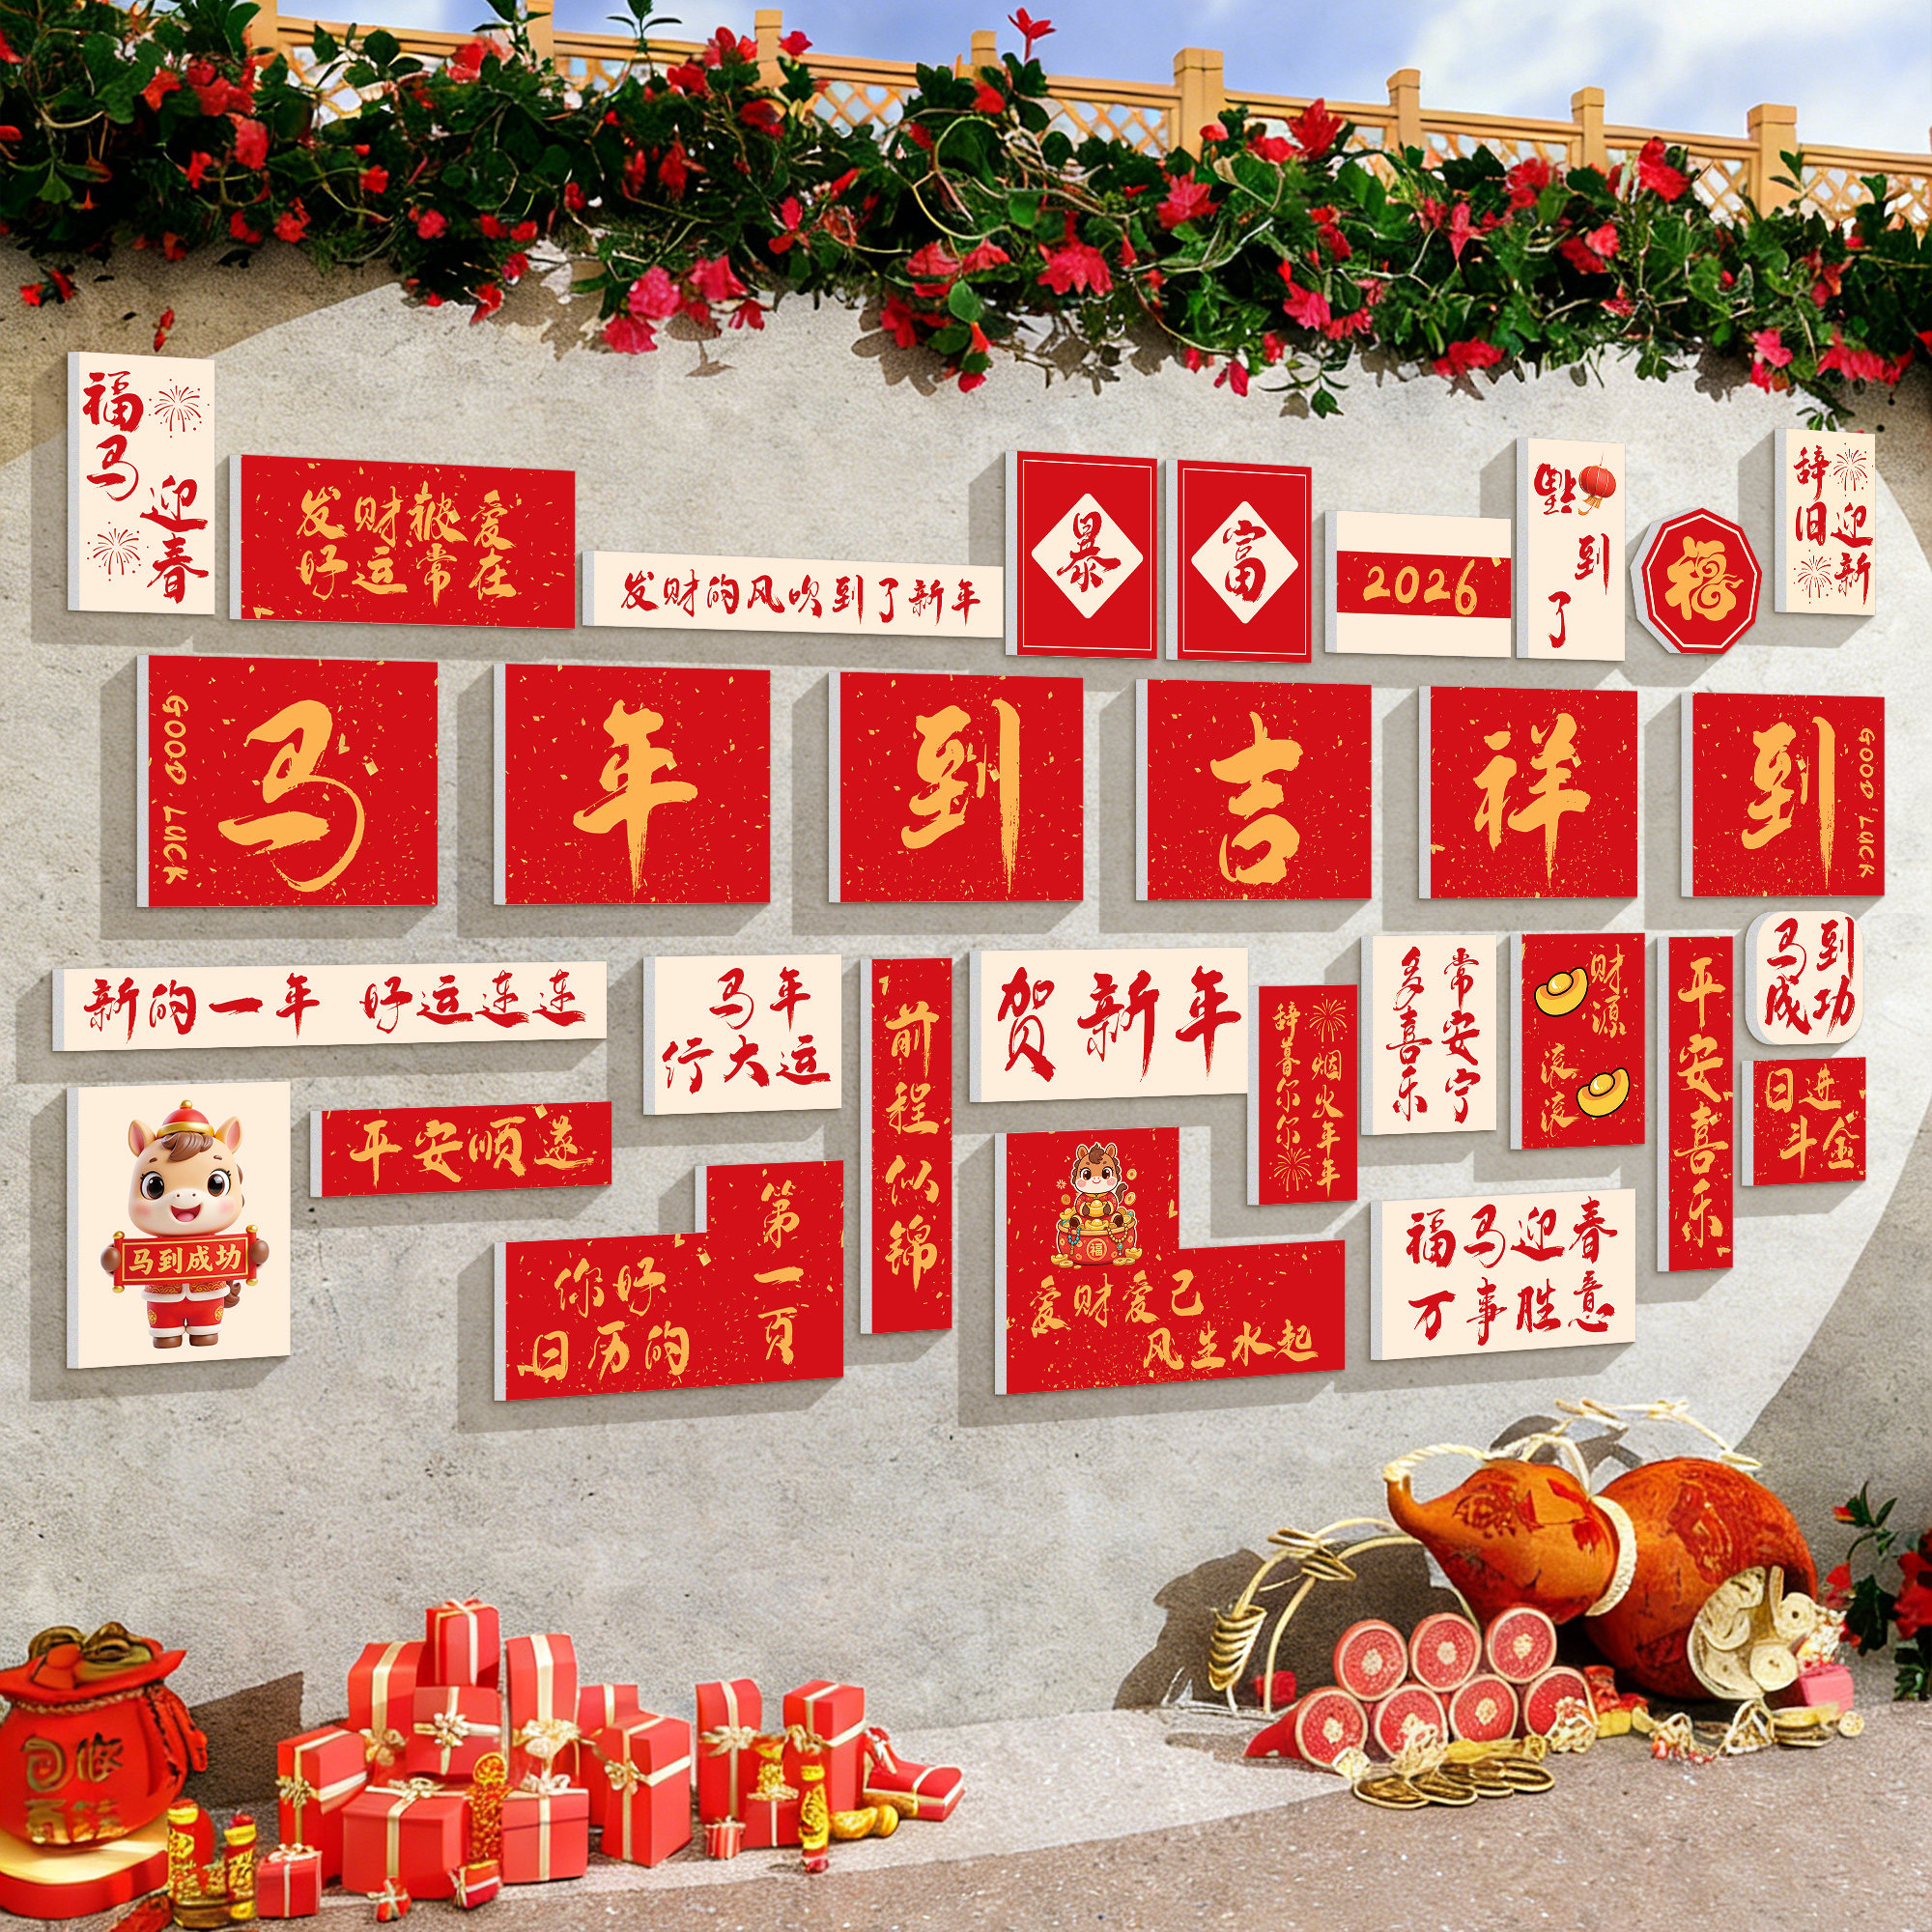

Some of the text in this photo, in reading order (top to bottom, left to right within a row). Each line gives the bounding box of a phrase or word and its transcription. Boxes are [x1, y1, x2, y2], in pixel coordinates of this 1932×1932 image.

[83, 371, 143, 501] 福马
[296, 481, 516, 551] 发财被爱
[1794, 445, 1831, 546] 辞旧
[140, 474, 209, 604] 迎春
[296, 543, 517, 608] 好运常在
[1056, 510, 1121, 593] 暴
[1222, 520, 1267, 604] 富
[1665, 536, 1744, 621] 福
[1830, 503, 1874, 606] 迎新
[621, 569, 980, 624] 发财的风吹到了新年
[1362, 559, 1478, 616] 2026
[162, 696, 188, 884] GOOD LUCK
[218, 700, 365, 892] 马
[573, 699, 697, 896] 年
[901, 697, 1020, 894] 到
[1210, 712, 1303, 886] 吉
[1473, 713, 1591, 880] 祥
[1742, 717, 1835, 889] 到
[1859, 728, 1875, 878] GOOD LUCK
[1767, 917, 1854, 978] 马到
[84, 969, 585, 1039] 新的一年 好运连连
[709, 967, 810, 1030] 马年
[998, 966, 1241, 1082] 贺新年
[1591, 944, 1627, 1038] 财源
[1765, 974, 1855, 1035] 成功
[662, 1035, 831, 1094] 行大运
[1271, 1001, 1301, 1149] 辞暮尔尔
[1386, 947, 1433, 1122] 多喜乐
[1441, 948, 1481, 1123] 常安宁
[1312, 1050, 1343, 1196] 烟火年年
[1541, 1043, 1579, 1137] 滚滚
[1674, 961, 1728, 1246] 平安喜乐
[1766, 1066, 1840, 1112] 日进
[350, 1115, 593, 1188] 平安顺遂
[885, 1001, 939, 1291] 前程似锦
[1777, 1110, 1860, 1178] 斗金
[128, 1243, 242, 1276] 马到成功
[753, 1180, 804, 1365] 第一页
[1090, 1242, 1103, 1257] 福
[1406, 1197, 1617, 1268] 福马迎春
[554, 1257, 666, 1318] 你好
[1030, 1269, 1205, 1338] 爱财爱己
[1408, 1271, 1615, 1346] 万事胜意
[532, 1321, 689, 1381] 日历的
[1143, 1318, 1318, 1370] 风生水起
